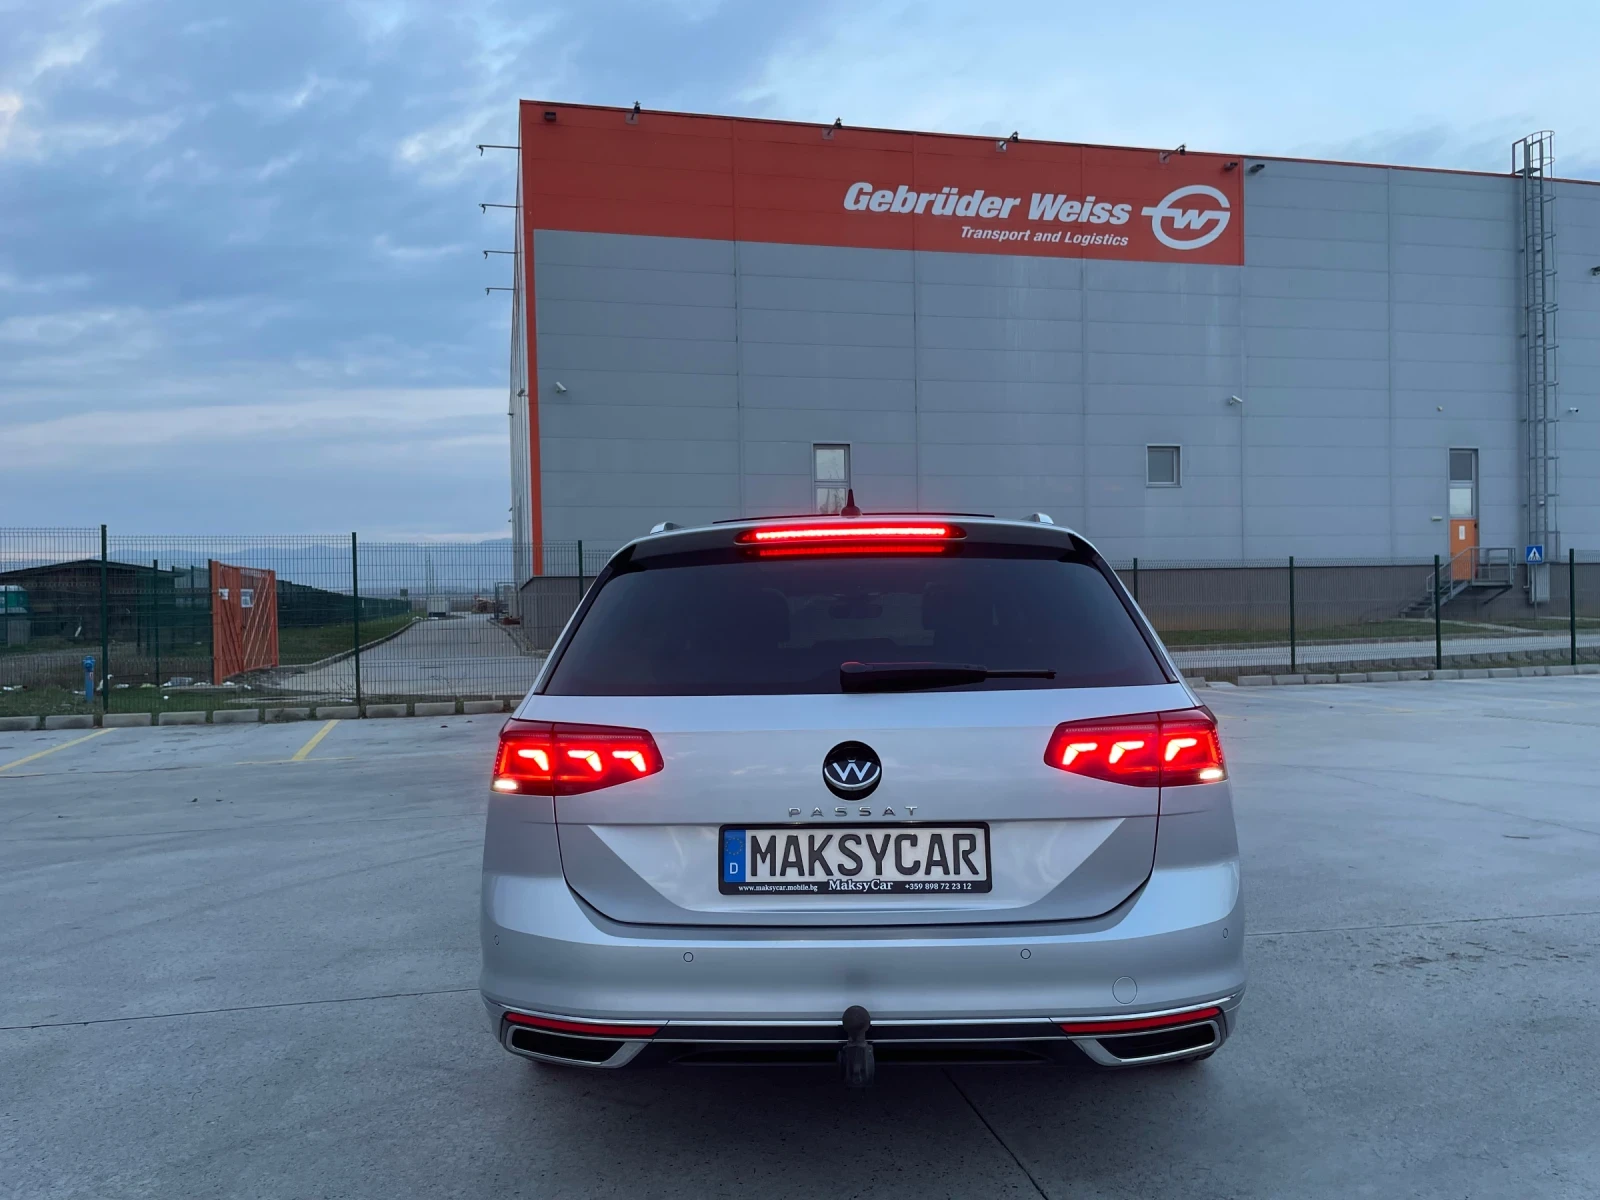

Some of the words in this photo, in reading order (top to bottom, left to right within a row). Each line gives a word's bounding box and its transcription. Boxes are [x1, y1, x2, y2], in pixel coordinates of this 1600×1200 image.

[843, 181, 1020, 221] Gebrüder
[1027, 192, 1132, 226] Weiss
[961, 226, 1031, 242] Transport
[1033, 231, 1062, 243] and
[1064, 231, 1129, 246] Logistics
[788, 806, 919, 818] PASSAT
[750, 833, 980, 877] MAKSYCAR
[729, 862, 739, 875] D
[738, 884, 818, 893] www.maksycar.mobile.bg
[828, 879, 894, 892] MaksyCar
[904, 882, 923, 890] +359
[924, 882, 939, 890] 898
[940, 882, 950, 890] 72
[951, 882, 961, 890] 23
[963, 882, 972, 890] 12
